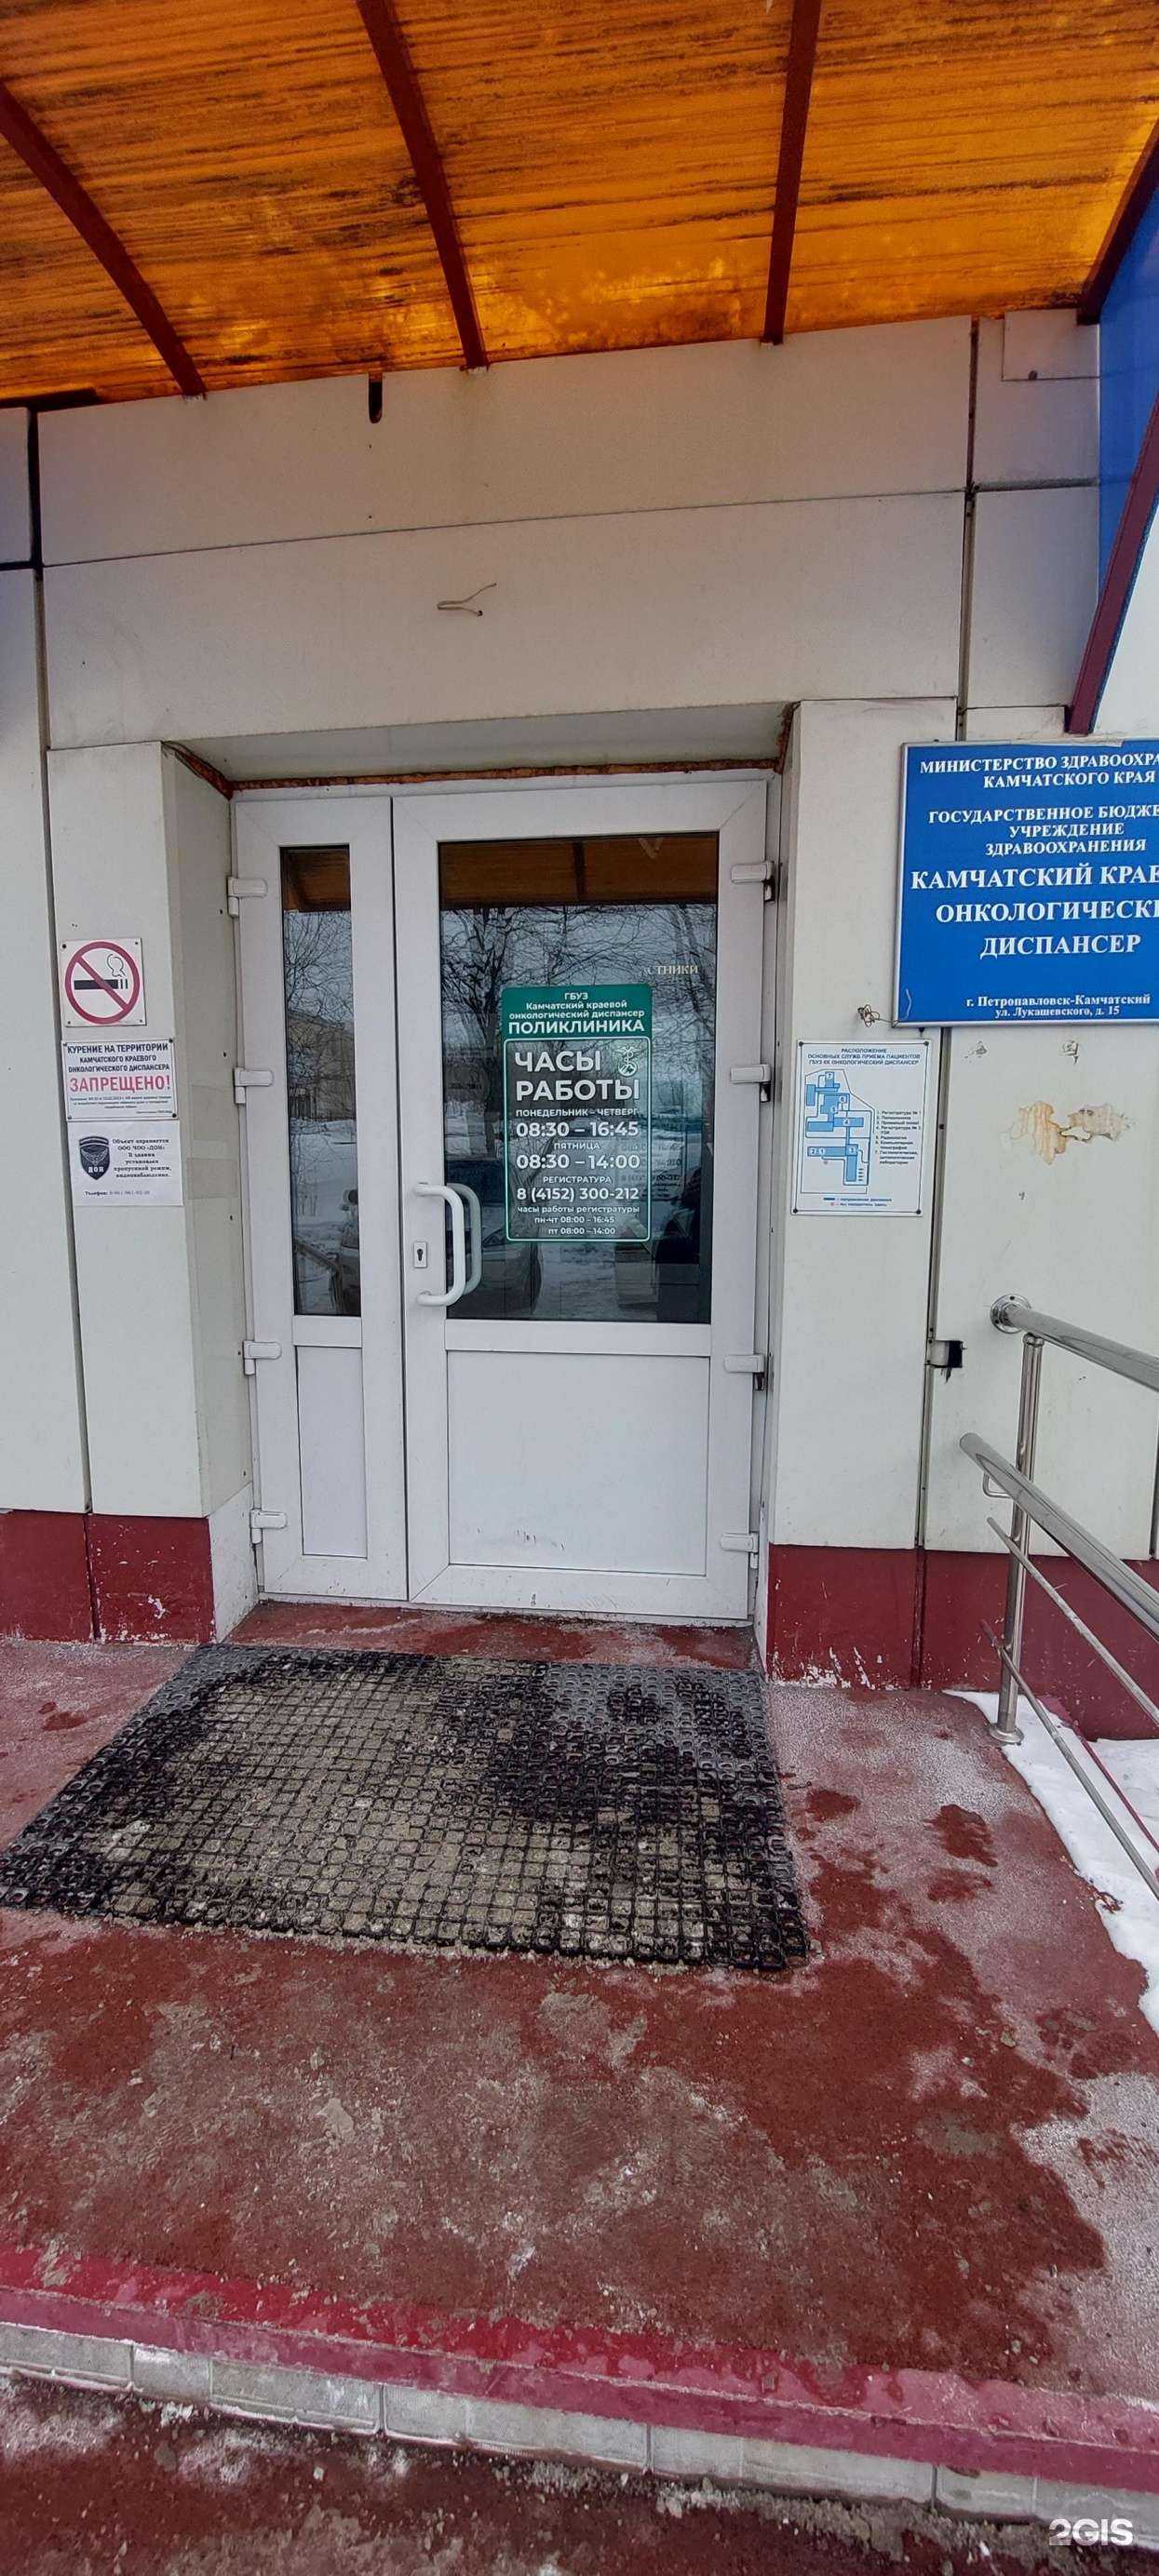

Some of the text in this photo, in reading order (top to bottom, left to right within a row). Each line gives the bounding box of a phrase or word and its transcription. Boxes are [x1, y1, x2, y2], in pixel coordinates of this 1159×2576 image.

[920, 757, 1058, 773] МИНИСТЕРСТВО
[983, 771, 1155, 788] КАМЧАТСКОГО КРАЯ
[928, 806, 1093, 825] ГОСУДАРСТВЕННОЕ
[1009, 823, 1125, 839] УЧРЕЖДЕНИЕ
[985, 839, 1147, 857] ЗДРАВООХРАНЕНИЯ
[910, 862, 1093, 890] КАМЧАТСКИЙ
[936, 899, 1159, 923] ОНКОЛОГИЧЕСК
[979, 934, 1141, 959] ДИСПАНСЕР
[564, 992, 588, 1000] ГБУЗ
[965, 993, 1152, 1009] г. Петропавловск-Камчатский
[526, 1000, 627, 1011] Камчатский краевой
[994, 1005, 1120, 1019] ул. Лукашевского, д. 15
[508, 1010, 645, 1020] онкологический диспансер
[508, 1019, 645, 1035] ПОЛИКЛИНИКА
[67, 1045, 103, 1053] КУРЕНИЕ
[117, 1043, 168, 1053] ТЕРРИТОРИИ
[68, 1064, 169, 1073] ОНКОЛОГИЧЕСКОГО ДИСПАНСЕРА
[515, 1050, 601, 1072] ЧАСЫ
[70, 1075, 170, 1093] ЗАПРЕЩЕНО!
[516, 1079, 640, 1102] РАБОТЫ
[516, 1109, 588, 1118] ПОНЕДЕЛЬНИК
[516, 1121, 570, 1137] 08:30
[589, 1121, 640, 1137] 16:45
[554, 1142, 600, 1150] ПЯТНИЦА
[516, 1154, 570, 1169] 08:30
[588, 1154, 640, 1170] 14:00
[543, 1175, 612, 1184] РЕГИСТРАТУРА
[517, 1187, 640, 1202] 8 (4152) 300-212
[542, 1205, 574, 1214] работы
